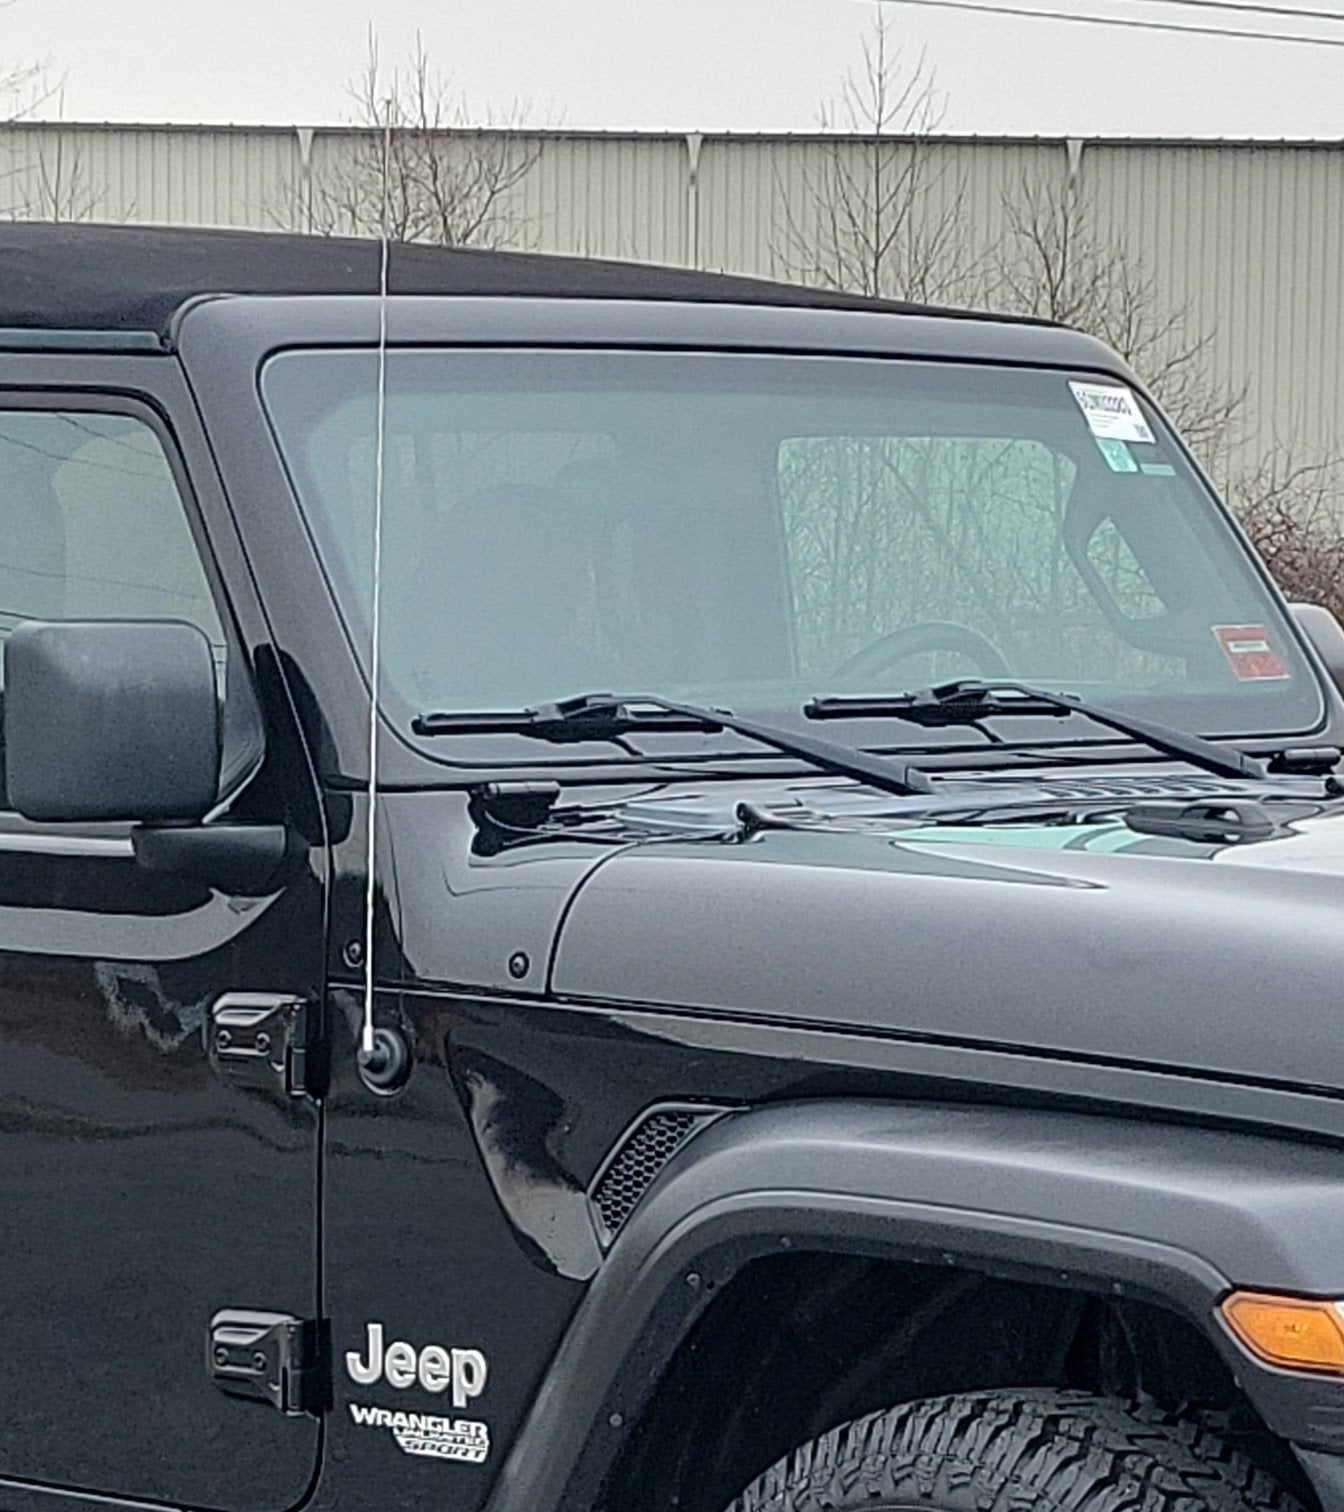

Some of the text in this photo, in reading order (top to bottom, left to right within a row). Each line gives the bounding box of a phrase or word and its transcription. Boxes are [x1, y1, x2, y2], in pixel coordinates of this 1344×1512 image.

[345, 1322, 488, 1409] Jeep
[348, 1402, 490, 1438] WRANGLER
[404, 1437, 487, 1460] SPORT
